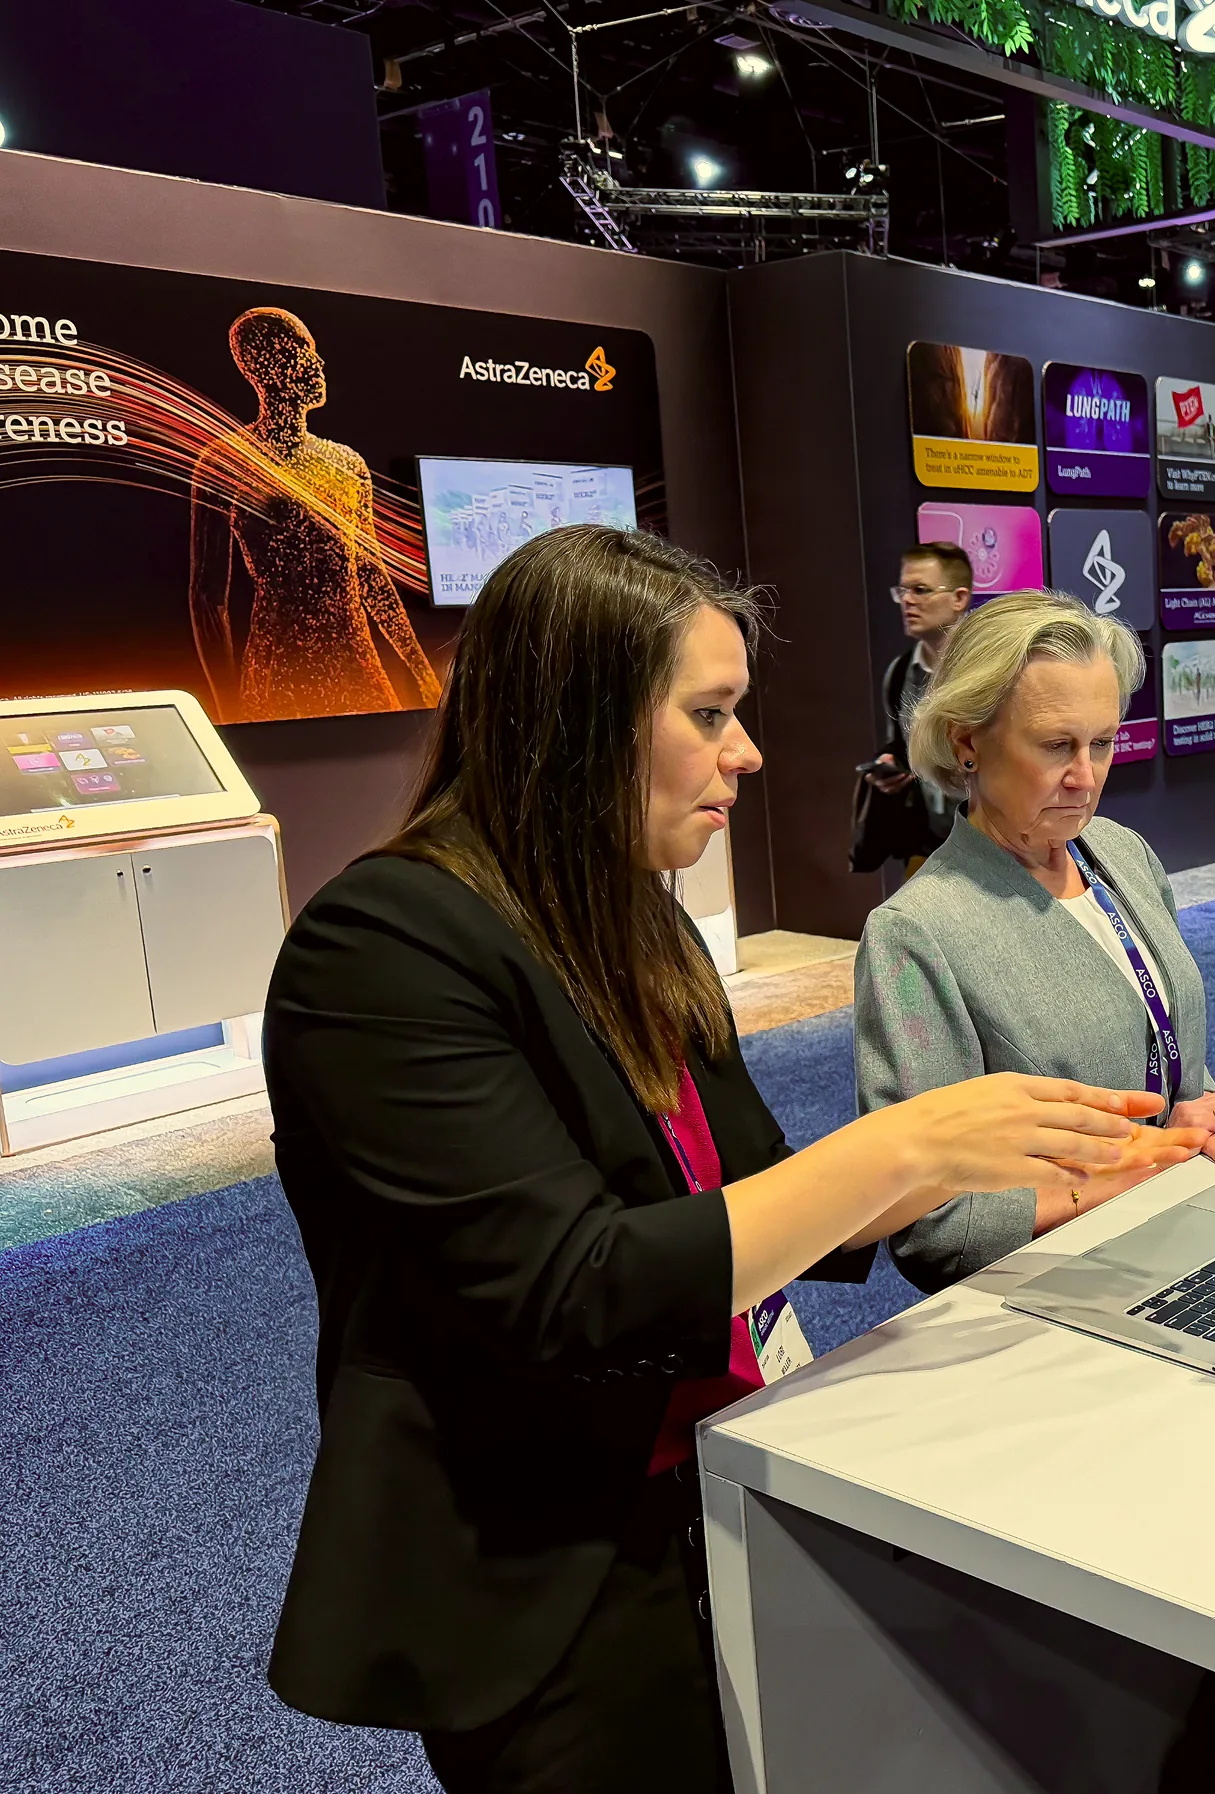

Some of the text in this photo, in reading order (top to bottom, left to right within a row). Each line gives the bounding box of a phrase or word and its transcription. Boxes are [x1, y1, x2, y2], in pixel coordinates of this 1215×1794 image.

[459, 355, 591, 391] AstraZeneca
[1065, 393, 1131, 423] LUNGPATH
[0, 414, 128, 446] eness
[1057, 465, 1092, 480] LungPath
[1076, 858, 1098, 886] ASCO
[1106, 910, 1127, 941] ASCO
[1135, 968, 1157, 999] ASCO
[1149, 1042, 1160, 1077] ASCO
[1162, 1028, 1179, 1061] ASCO
